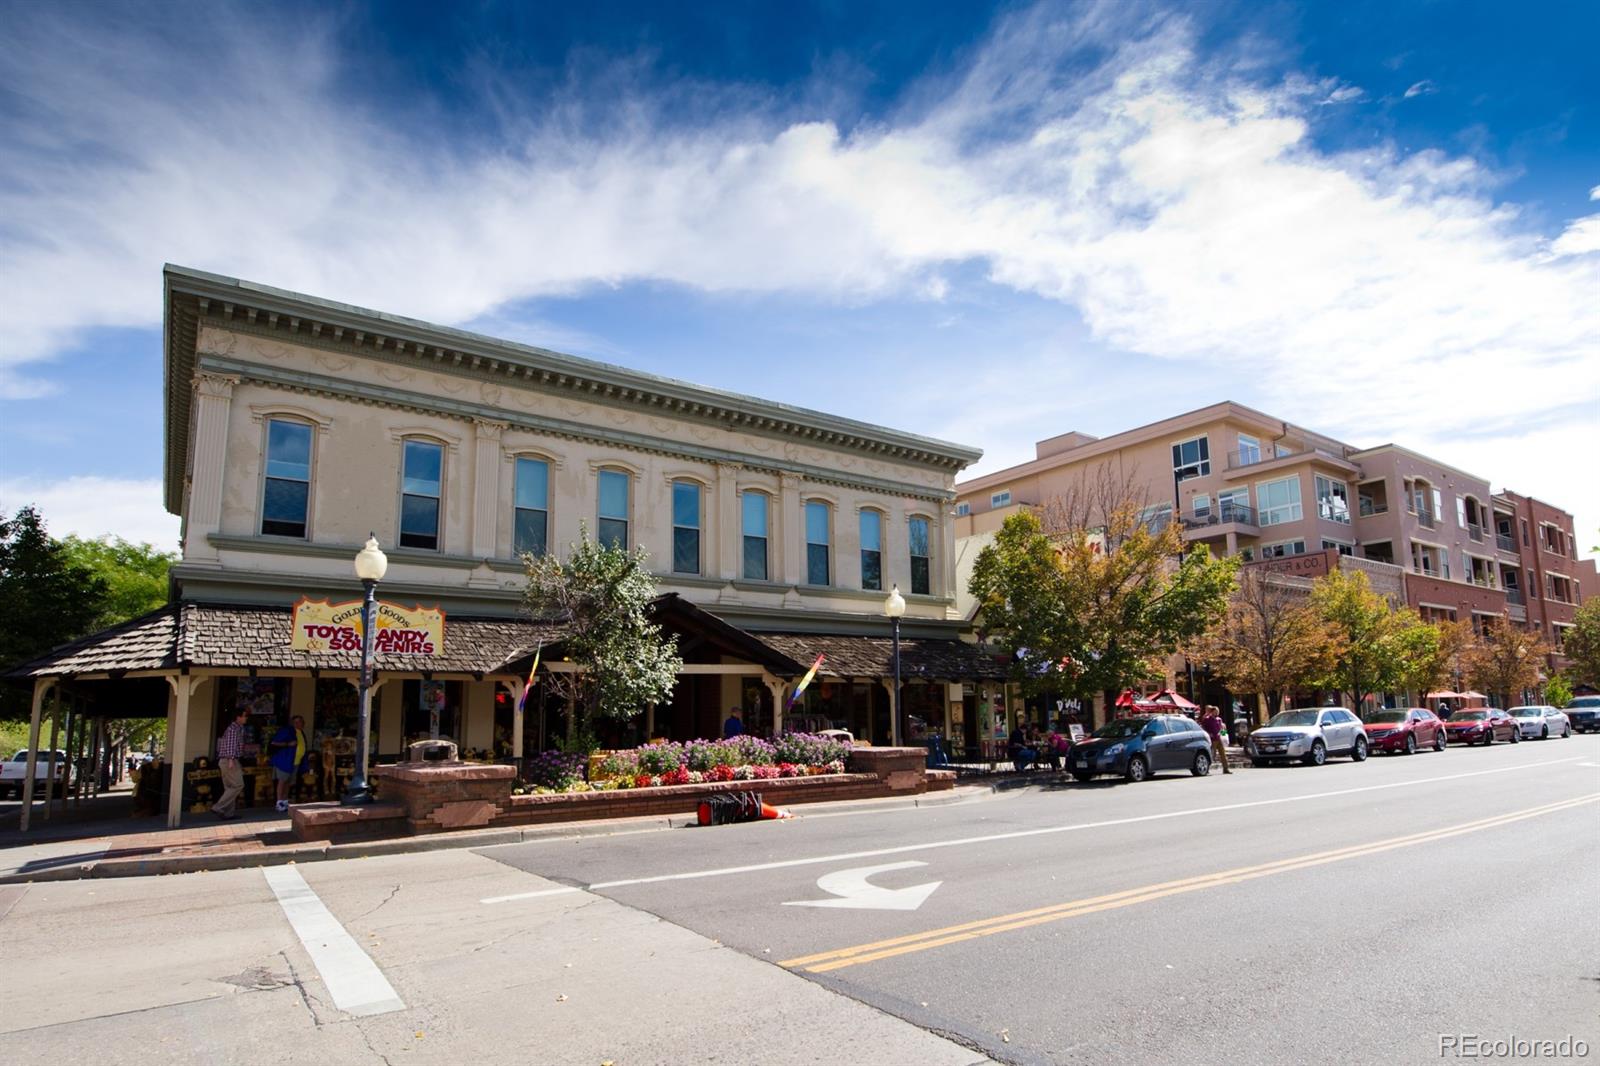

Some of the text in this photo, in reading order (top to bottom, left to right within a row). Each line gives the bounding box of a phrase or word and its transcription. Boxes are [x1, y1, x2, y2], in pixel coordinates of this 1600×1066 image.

[304, 625, 429, 642] TOYS, ANDY
[306, 638, 323, 649] &
